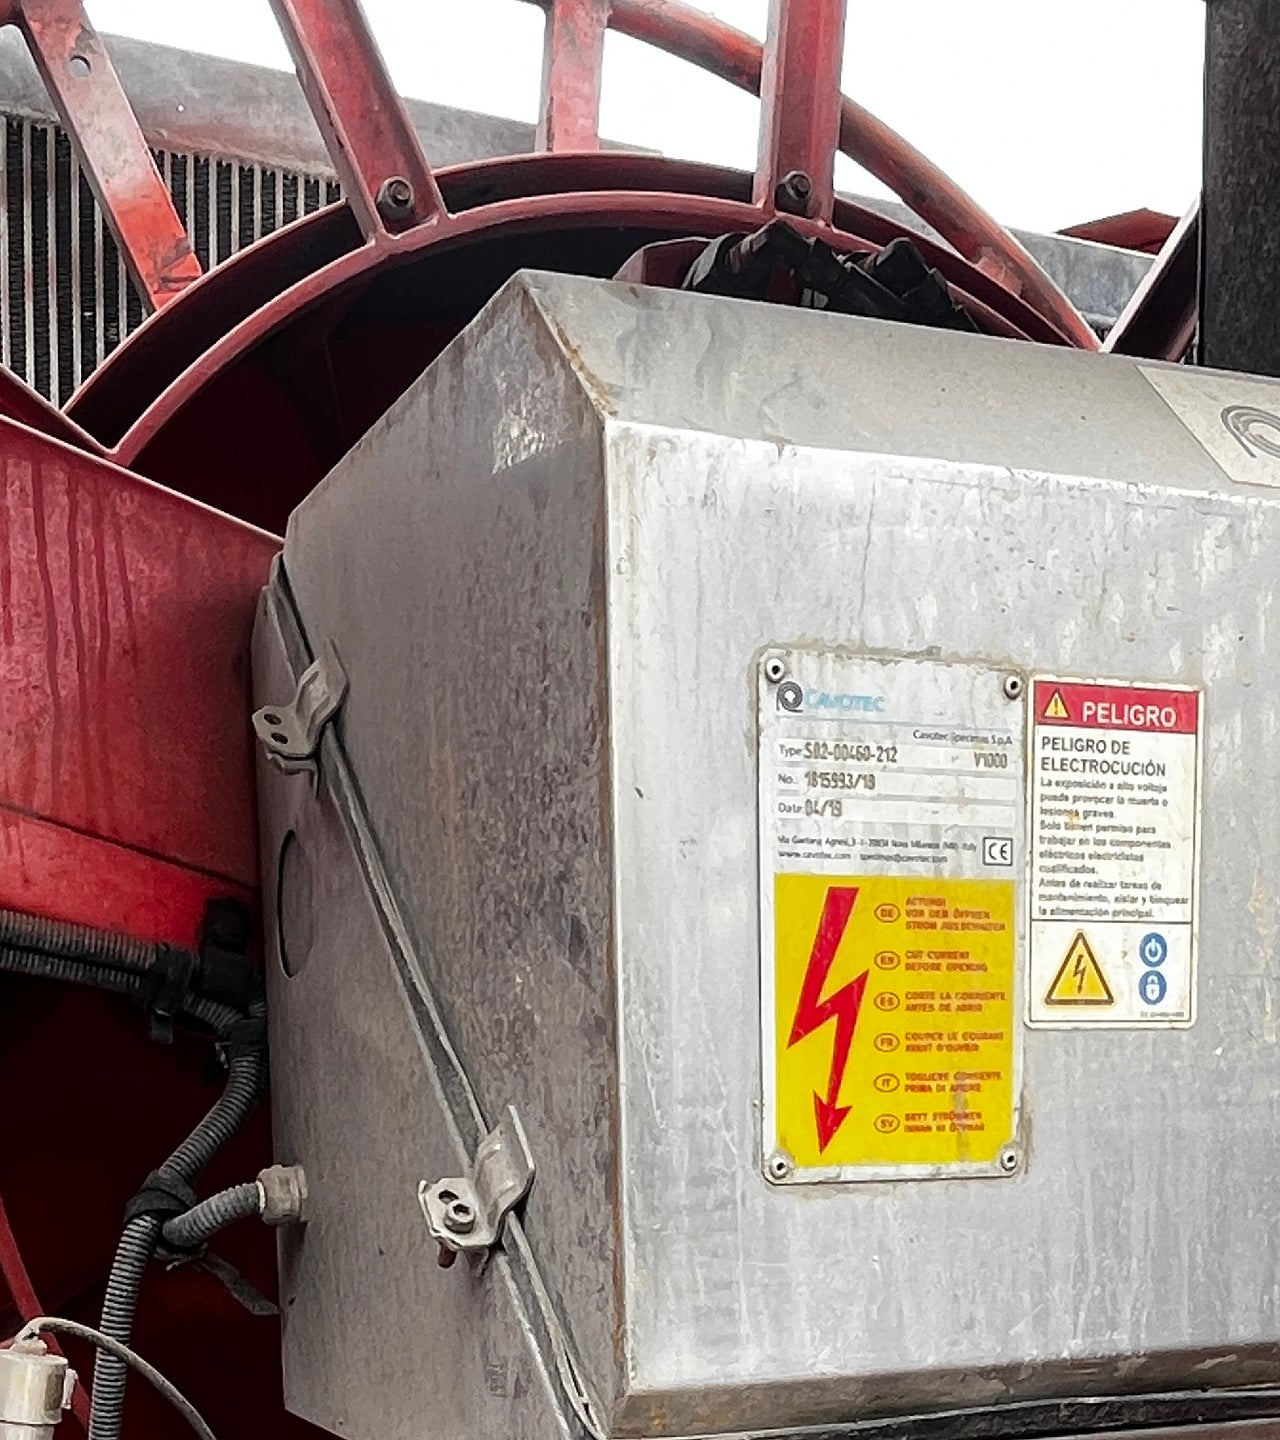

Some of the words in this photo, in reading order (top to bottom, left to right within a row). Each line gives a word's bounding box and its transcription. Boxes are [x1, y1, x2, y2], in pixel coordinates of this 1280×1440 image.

[805, 688, 885, 712] CAVOTEC
[1083, 701, 1177, 727] PELIGRO
[1041, 736, 1106, 754] PELIGRO
[1111, 740, 1131, 755] DE
[1041, 757, 1166, 777] ELECTROCUCIÓN
